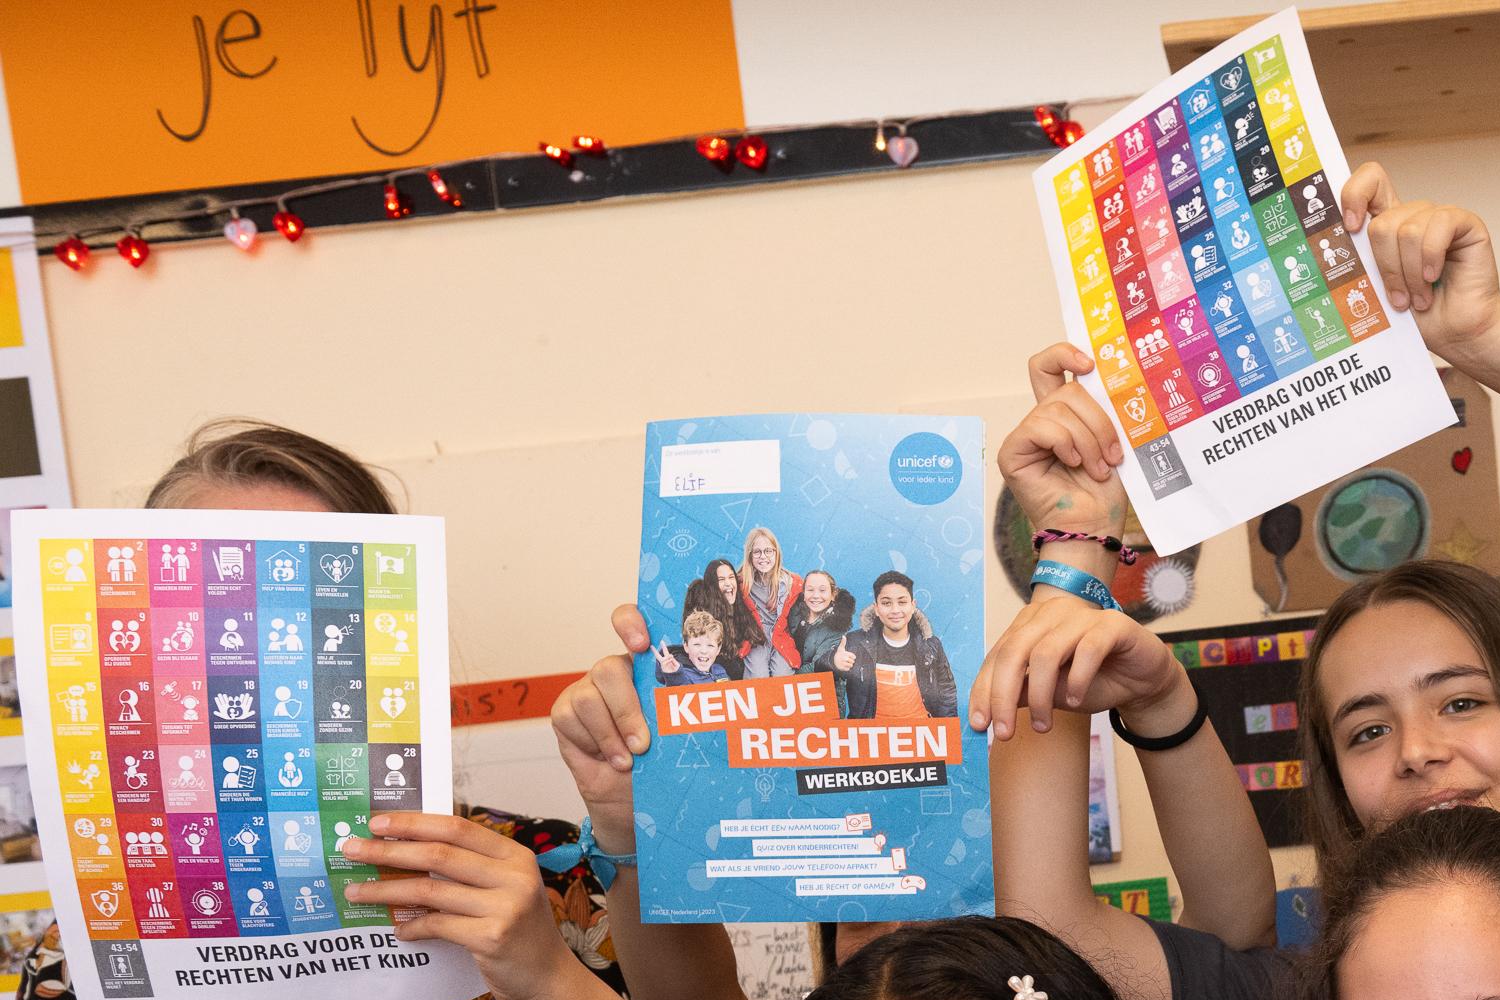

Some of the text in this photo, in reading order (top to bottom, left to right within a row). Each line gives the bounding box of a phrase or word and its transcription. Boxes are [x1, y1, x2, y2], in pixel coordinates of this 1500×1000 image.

[156, 9, 278, 142] je
[1212, 353, 1364, 434] VERDRAG VOOR DE
[1202, 365, 1392, 465] RECHTEN VAN HET KIND
[897, 455, 938, 468] unicef
[668, 681, 826, 727] KEN JE
[740, 725, 948, 761] RECHTEN
[804, 766, 938, 789] WERKBOEKJE
[813, 823, 840, 831] NODIG?
[863, 882, 895, 890] GAMEN?
[111, 943, 138, 953] 43-54
[196, 933, 398, 963] VERDRAG VOOR DE
[175, 951, 431, 987] RECHTEN VAN HET KIND
